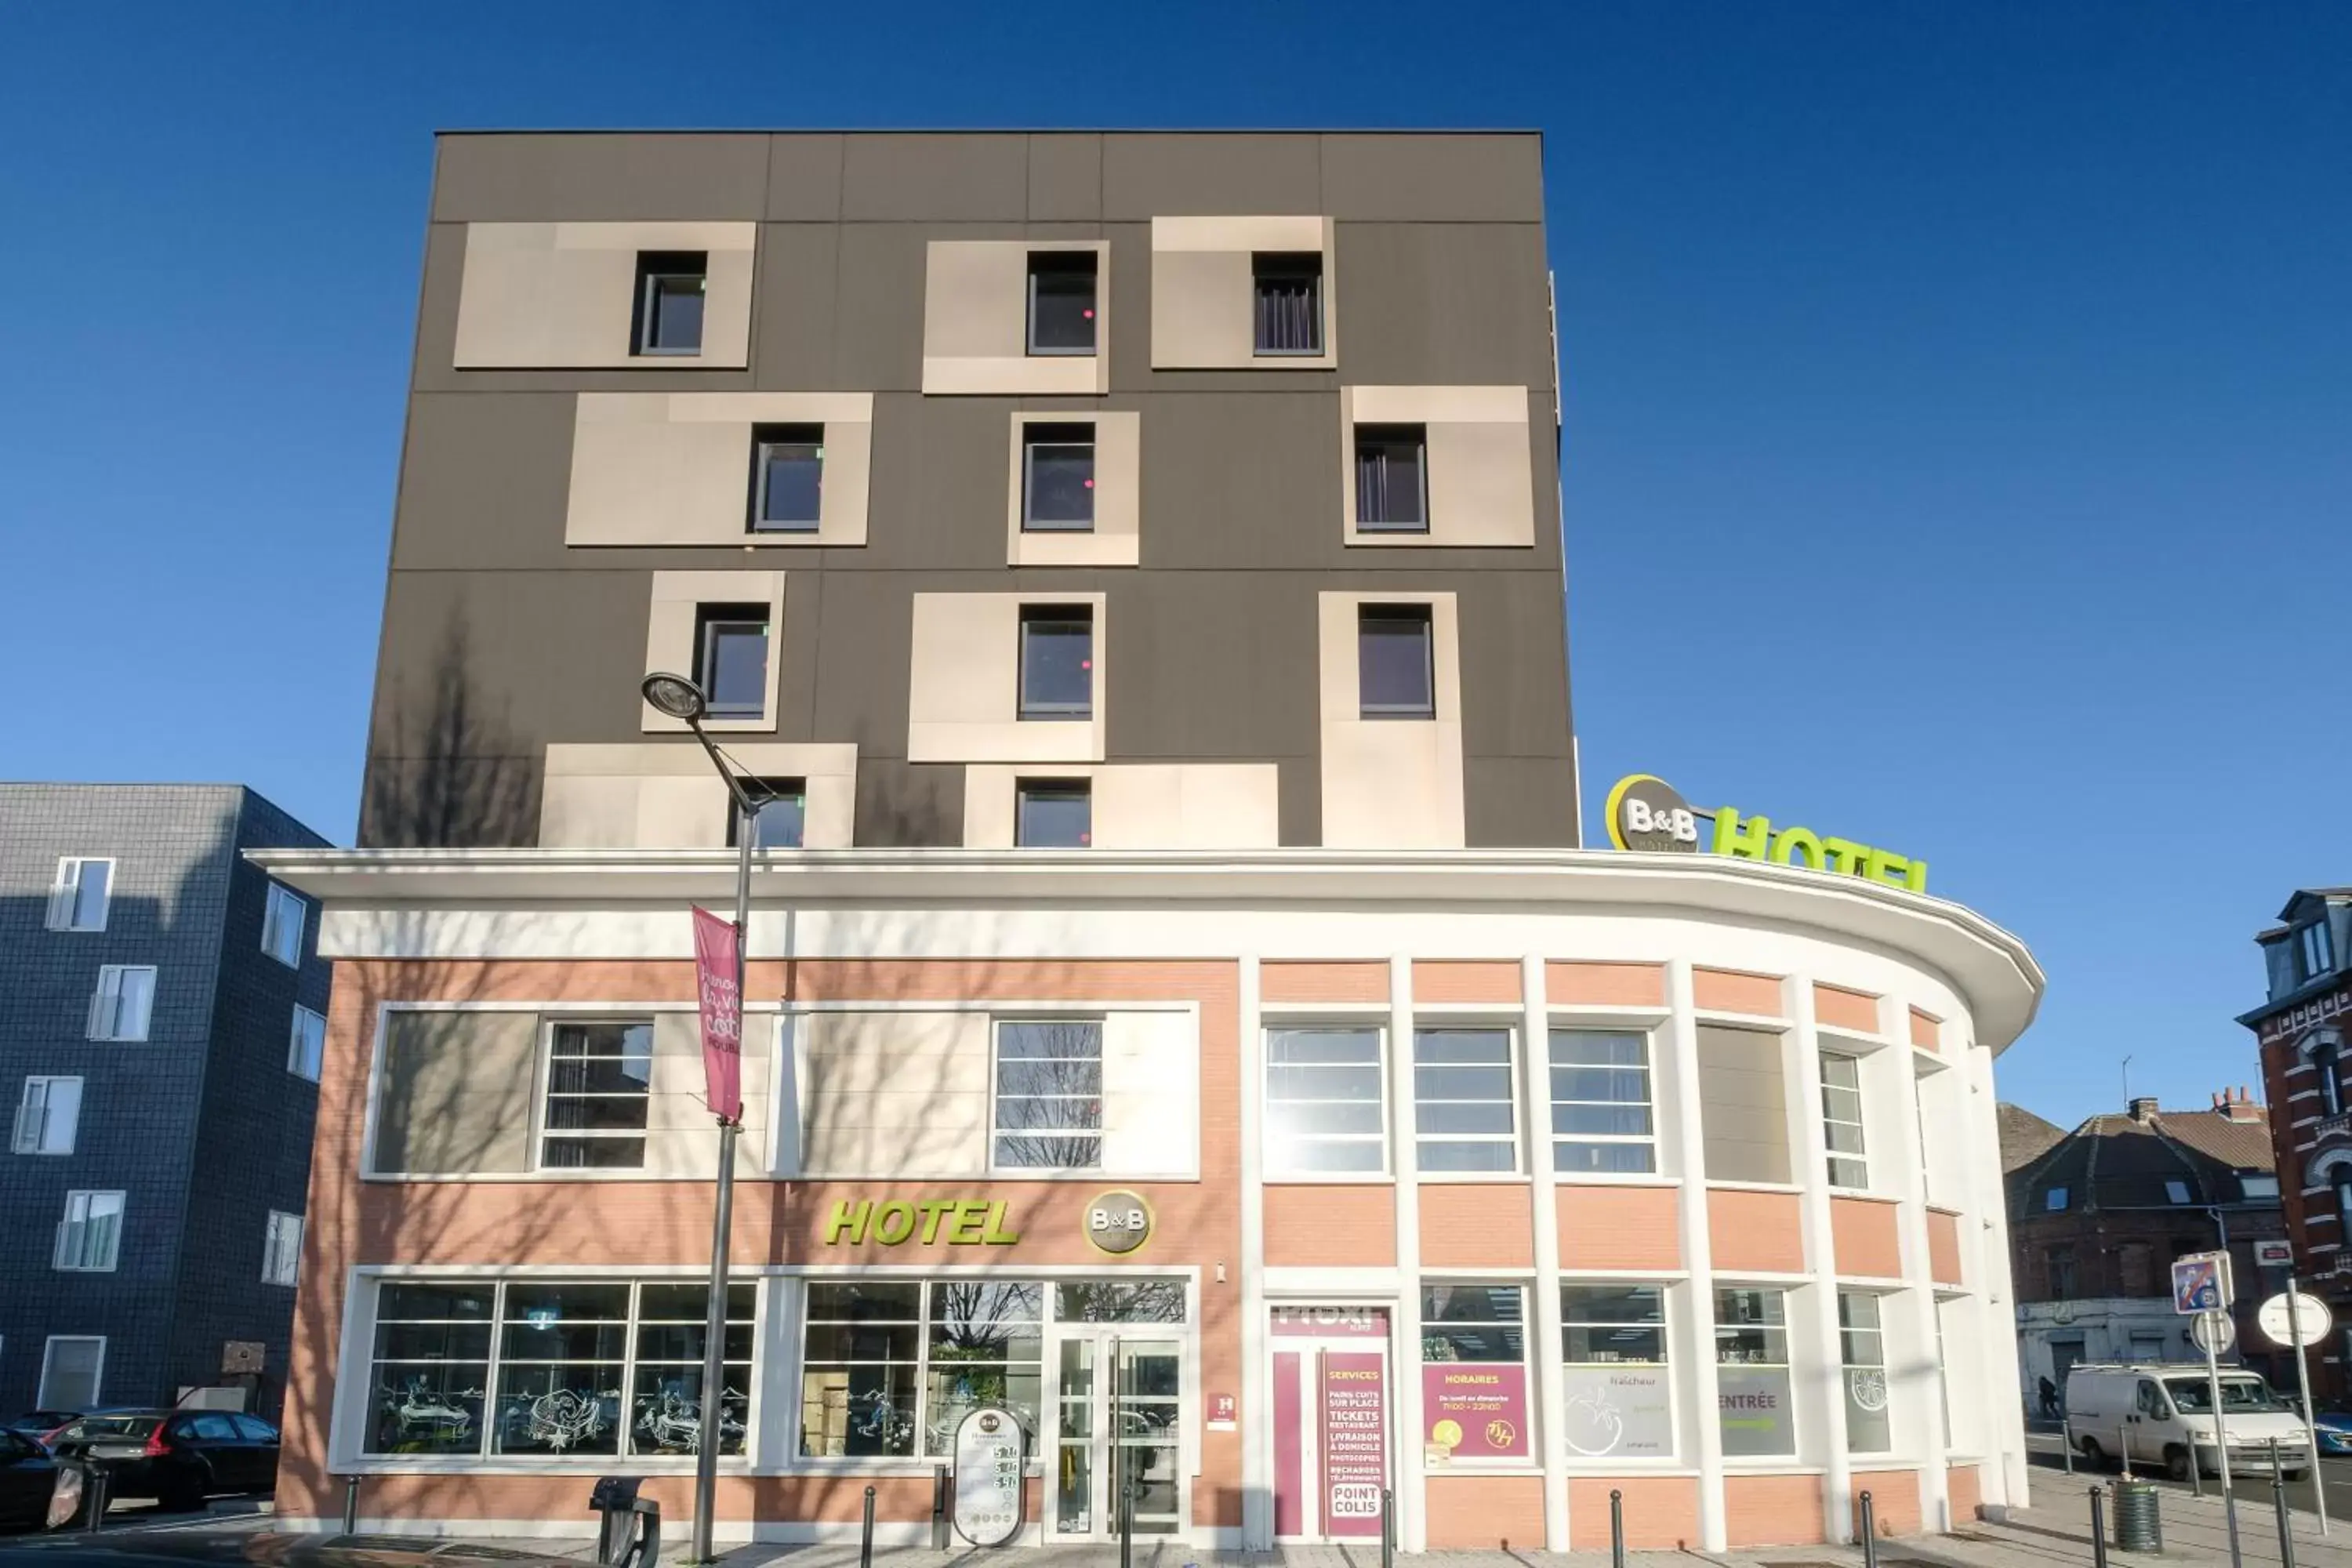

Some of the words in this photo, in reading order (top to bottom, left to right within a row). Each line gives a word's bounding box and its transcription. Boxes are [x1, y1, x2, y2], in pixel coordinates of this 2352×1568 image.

[1626, 797, 1697, 843] B&B
[826, 1200, 1021, 1246] HOTEL
[1092, 1208, 1145, 1232] B&B
[1329, 1370, 1379, 1380] SERVICES
[1445, 1374, 1499, 1384] HORAIRES
[1719, 1390, 1777, 1409] ENTRÉE
[1329, 1410, 1379, 1421] TICKETS
[1330, 1432, 1380, 1441] LIVRAISON
[1334, 1487, 1377, 1499] POINT
[1335, 1501, 1376, 1512] COLIS
